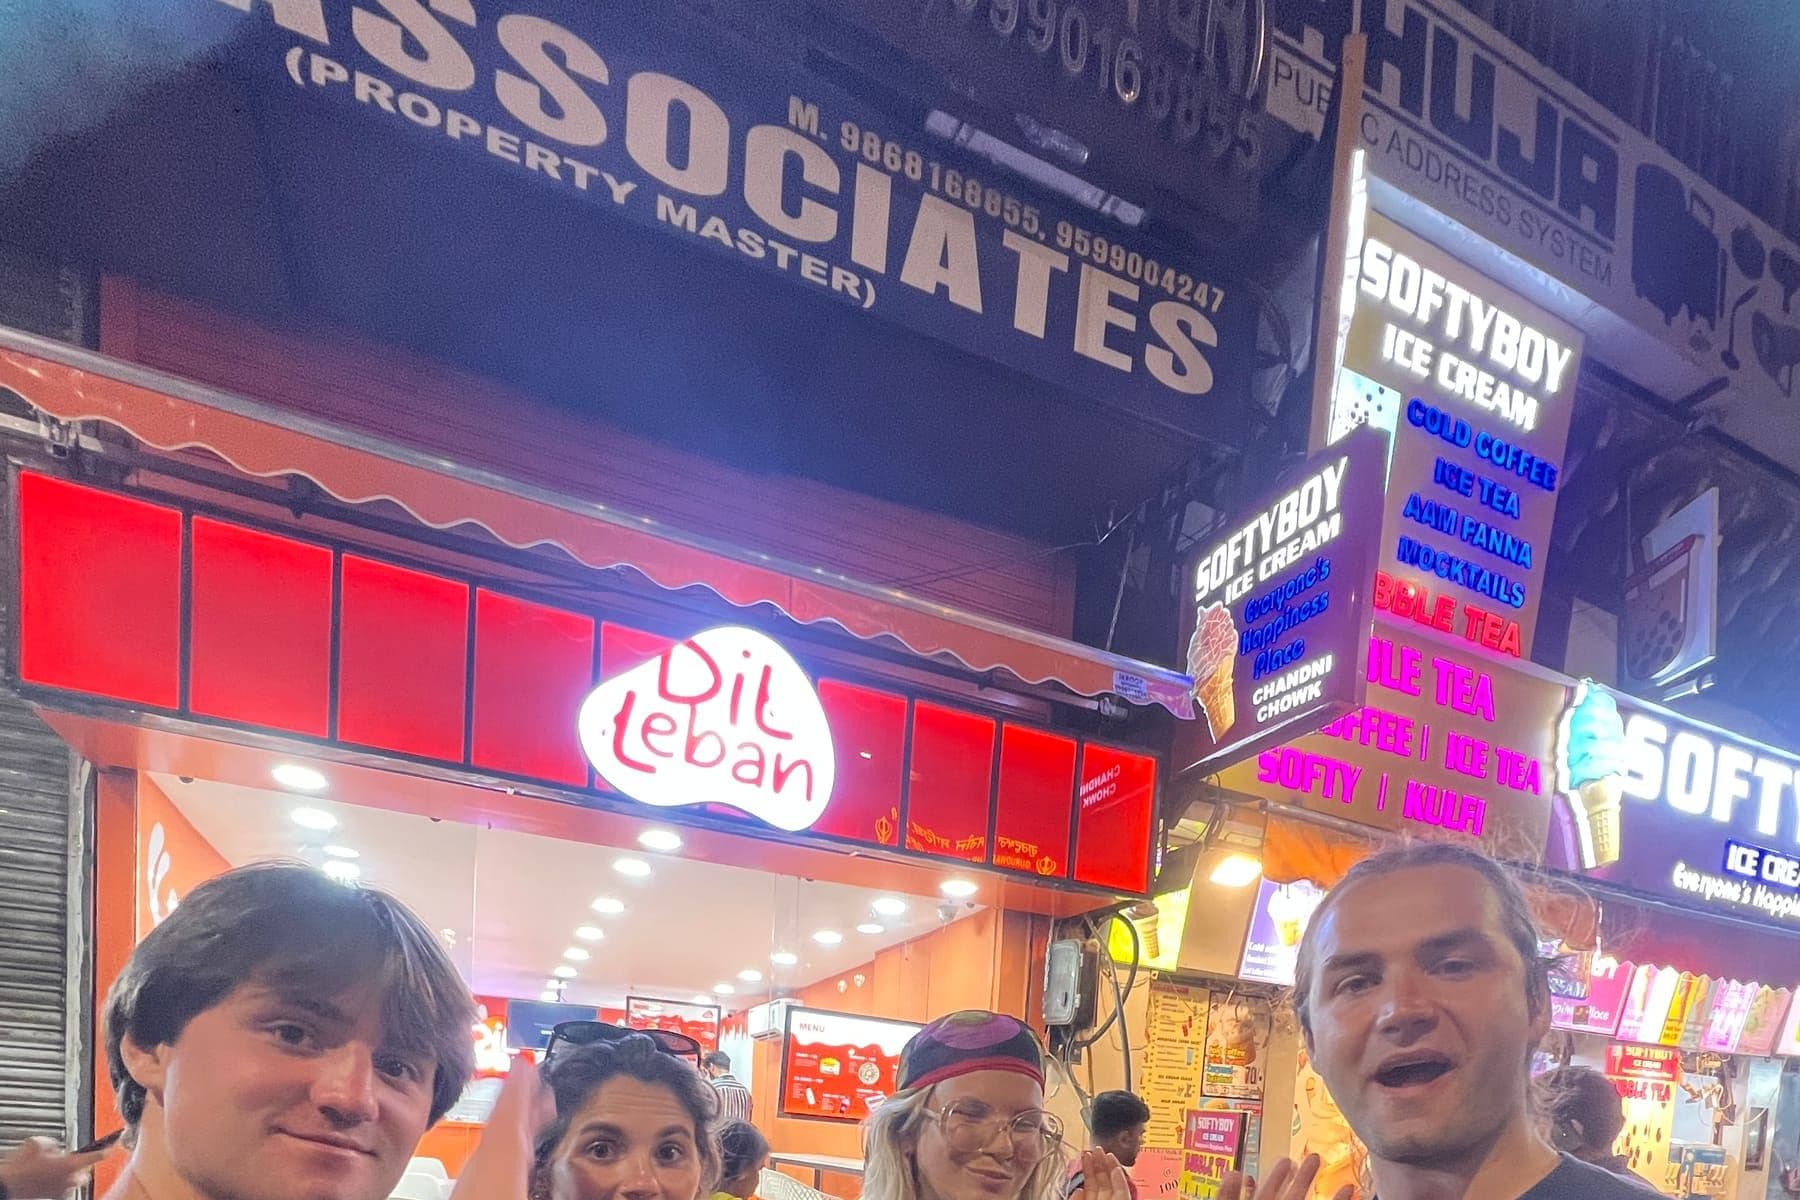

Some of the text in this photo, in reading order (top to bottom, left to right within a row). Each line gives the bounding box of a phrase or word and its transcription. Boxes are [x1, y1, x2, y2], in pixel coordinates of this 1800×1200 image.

[788, 96, 828, 141] M.
[286, 46, 877, 309] (PROPERTY MASTER)
[1386, 137, 1512, 227] ADDRESS
[1518, 207, 1613, 288] SYSTEM
[1360, 238, 1572, 394] SOFTYBOY
[1382, 323, 1538, 431] ICE CREAM
[1407, 397, 1559, 491] COLD COFFEE
[1434, 456, 1520, 519] ICE TEA
[1195, 456, 1348, 602] SOFTYBOY
[1225, 512, 1341, 605] ICE CREAM
[1402, 492, 1533, 570] AAM PANNA
[1244, 556, 1331, 624] Everyone's
[1396, 536, 1526, 608] MOCKTAILS
[1240, 591, 1330, 656] Happiness
[1373, 570, 1522, 658] BBLE TEA
[1252, 654, 1333, 706] CHANDNI
[1253, 638, 1305, 680] Place
[1433, 656, 1496, 722] TEA
[1256, 680, 1323, 724] CHOWK
[613, 690, 813, 802] Leban
[1445, 730, 1489, 779] ICE
[1495, 746, 1542, 796] TEA
[1620, 714, 1800, 845] SOFT
[1257, 745, 1487, 836] SOFTY KULFI
[1673, 861, 1752, 904] Everyone's
[1726, 844, 1800, 888] ICE CRE
[799, 1022, 826, 1033] MENU
[1197, 1116, 1235, 1132] SOFTYBOY
